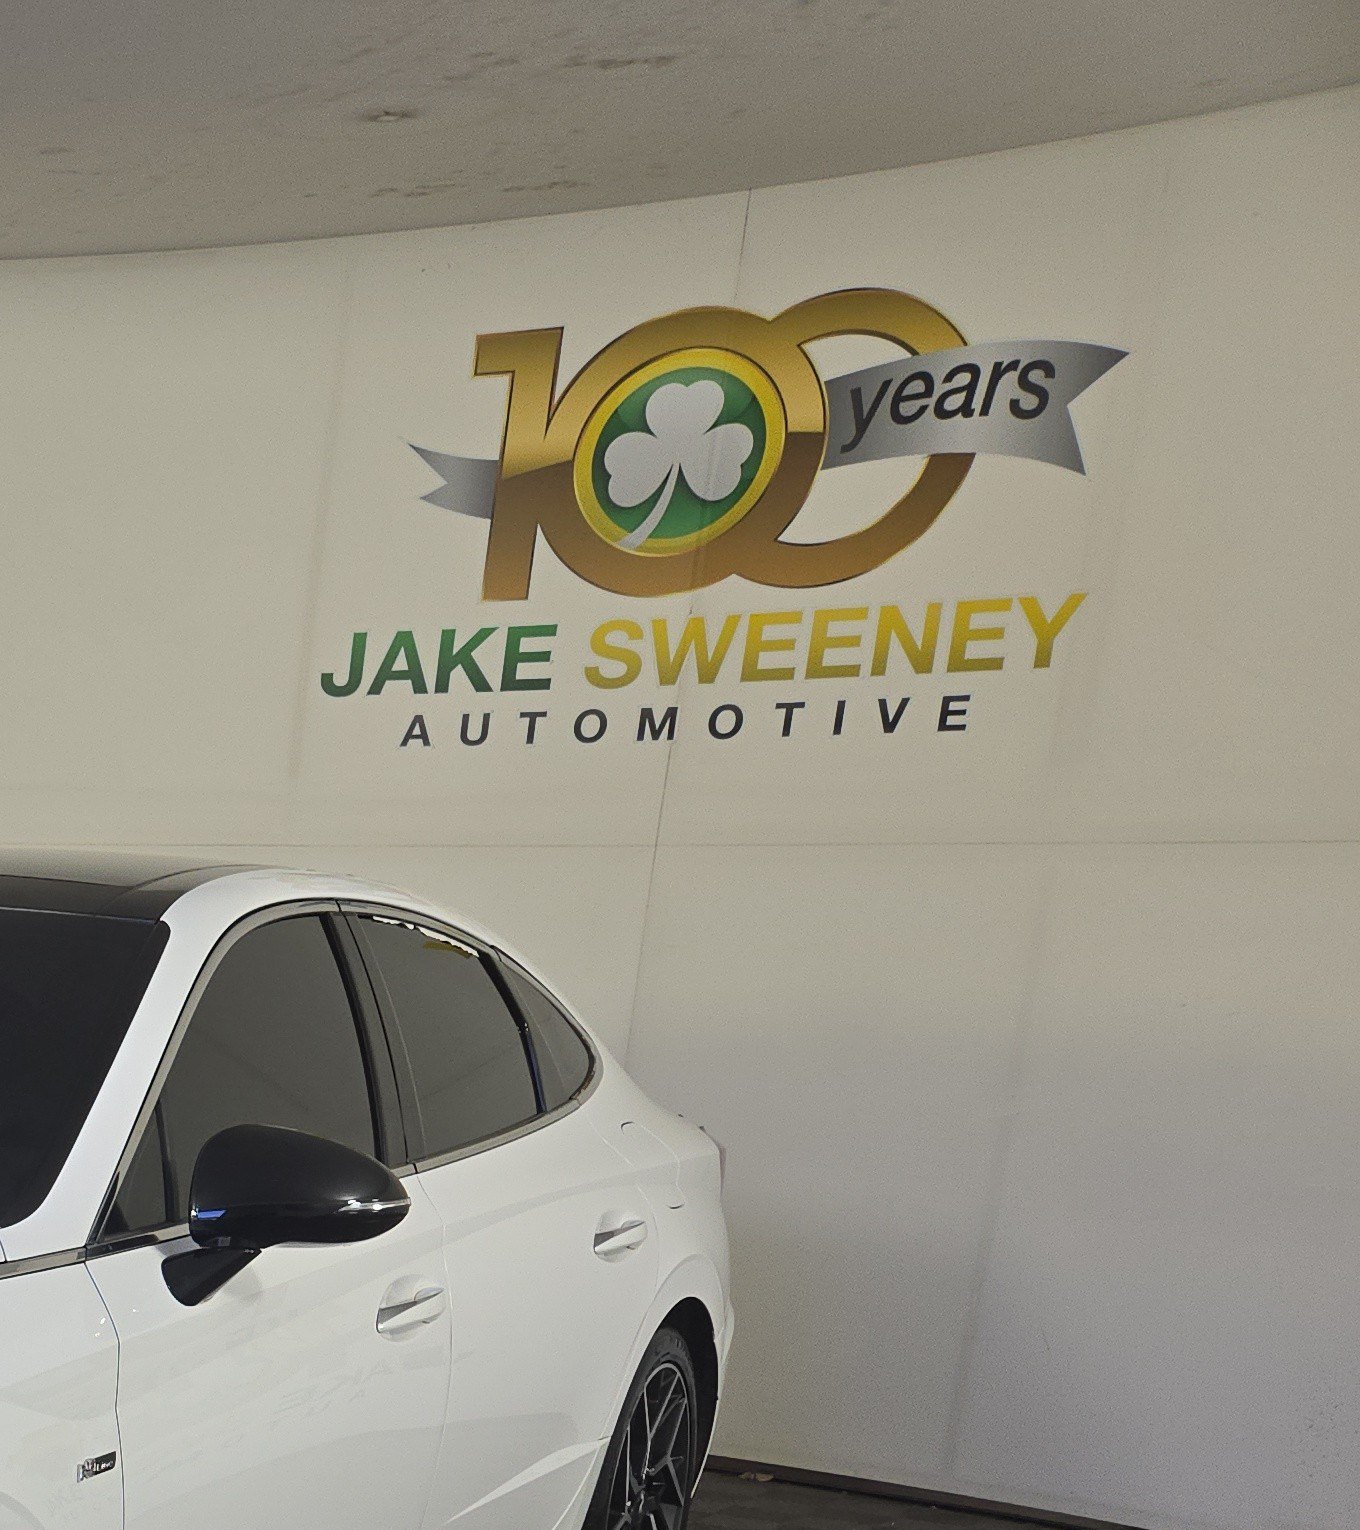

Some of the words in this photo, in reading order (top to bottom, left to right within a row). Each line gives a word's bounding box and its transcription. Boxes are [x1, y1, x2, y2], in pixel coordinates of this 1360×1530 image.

[840, 352, 1056, 453] years
[320, 623, 558, 697] JAKE
[583, 593, 1087, 690] SWEENEY
[400, 693, 971, 748] AUTOMOTIVE
